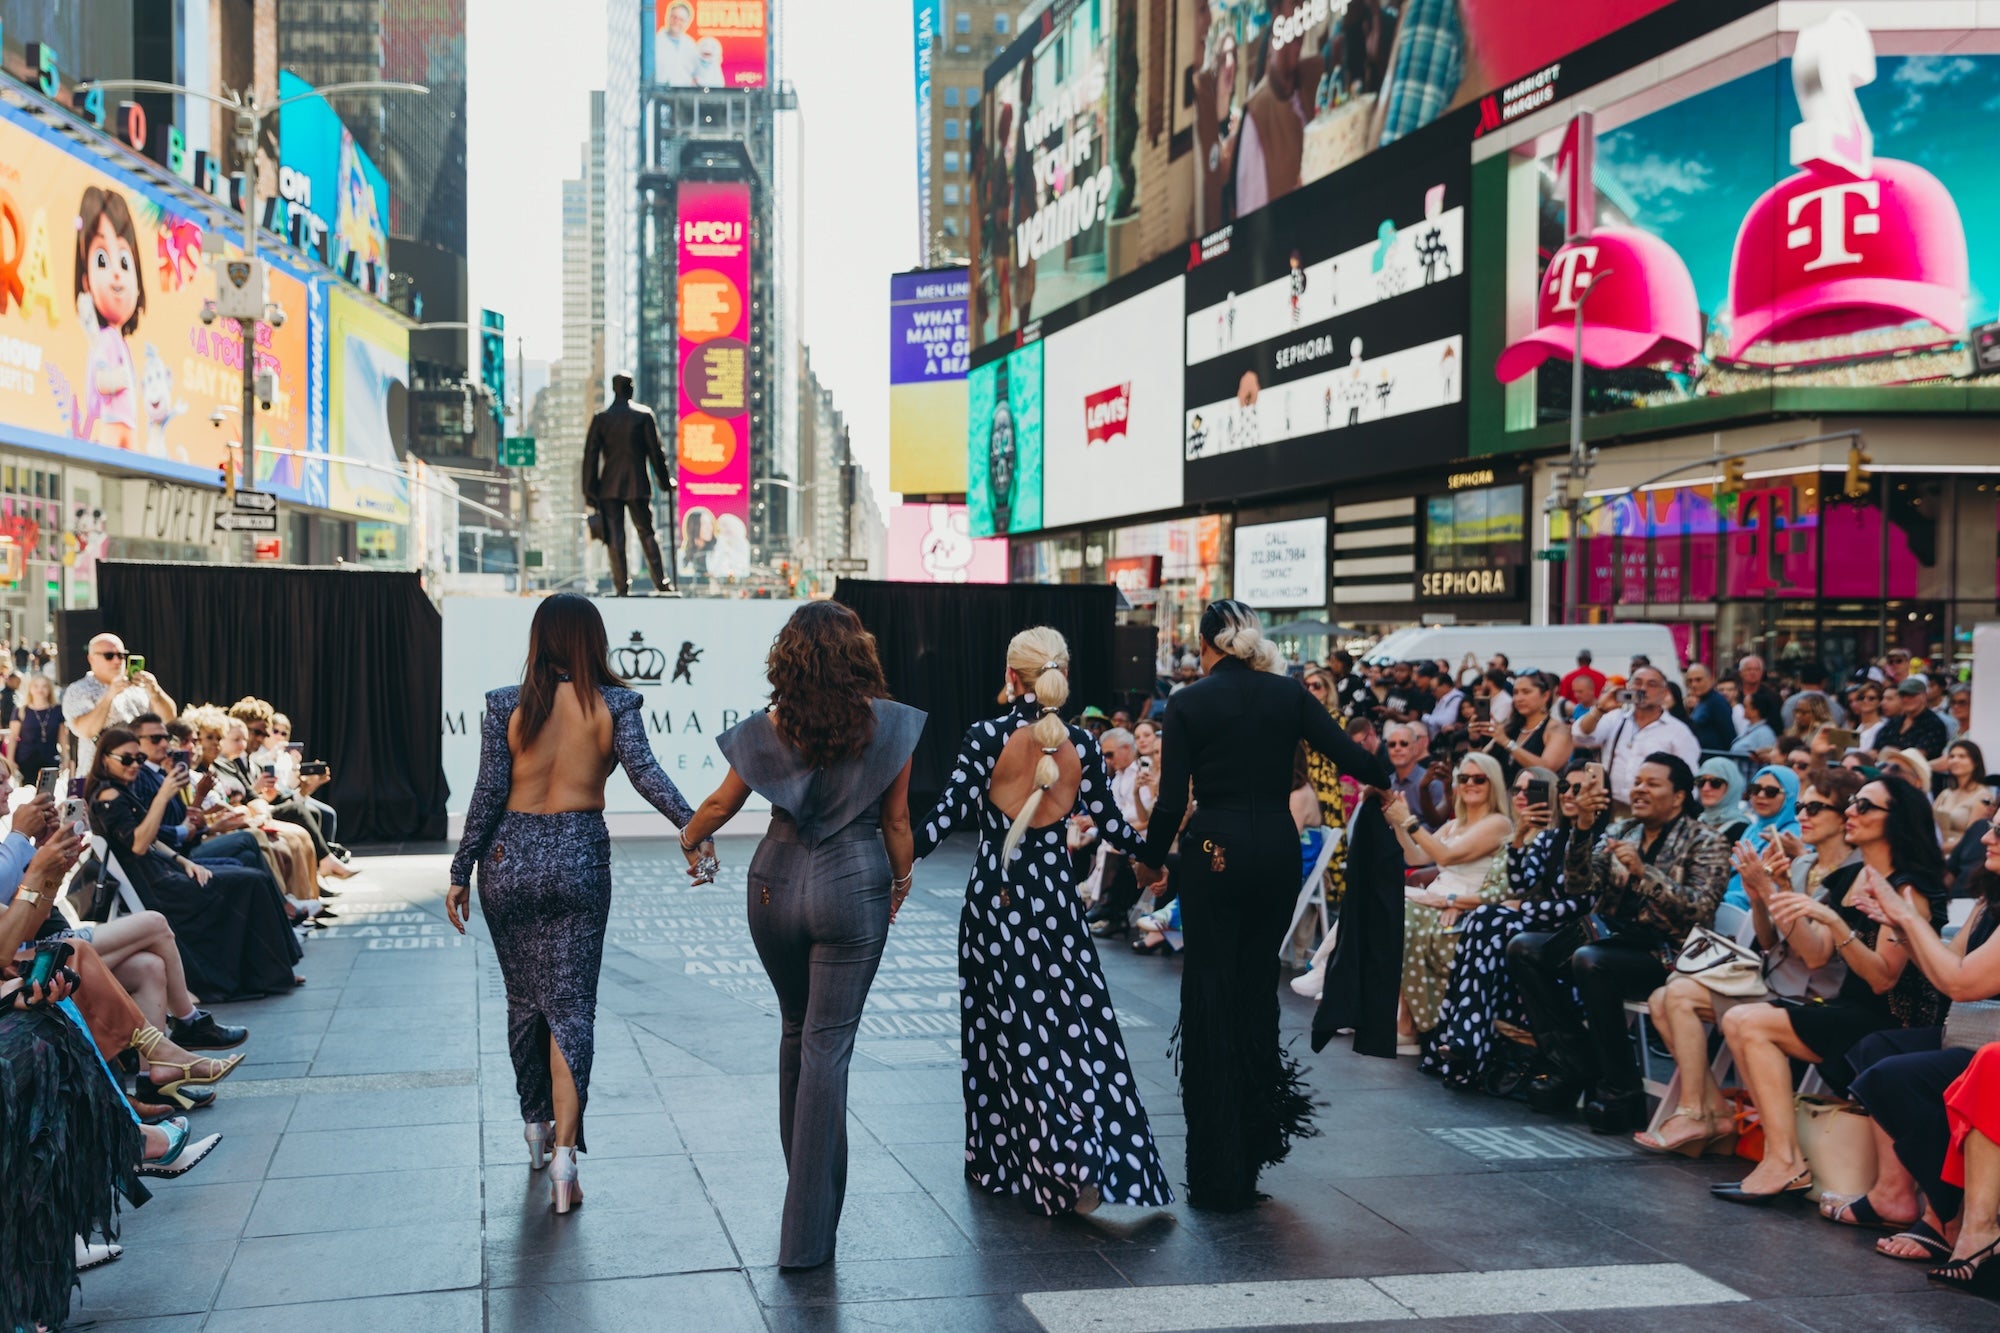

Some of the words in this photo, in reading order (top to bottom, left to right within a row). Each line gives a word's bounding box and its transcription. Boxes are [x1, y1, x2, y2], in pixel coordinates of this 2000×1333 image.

[1503, 63, 1560, 104] MARRIOTT
[1503, 84, 1554, 120] MARQUIS
[916, 284, 945, 299] MEN
[912, 308, 964, 328] WHAT
[906, 325, 951, 345] MAIN
[924, 341, 949, 359] TO
[1276, 335, 1333, 369] SEPHORA
[924, 358, 939, 376] A
[1447, 469, 1495, 490] SEPHORA
[1422, 569, 1506, 597] SEPHORA
